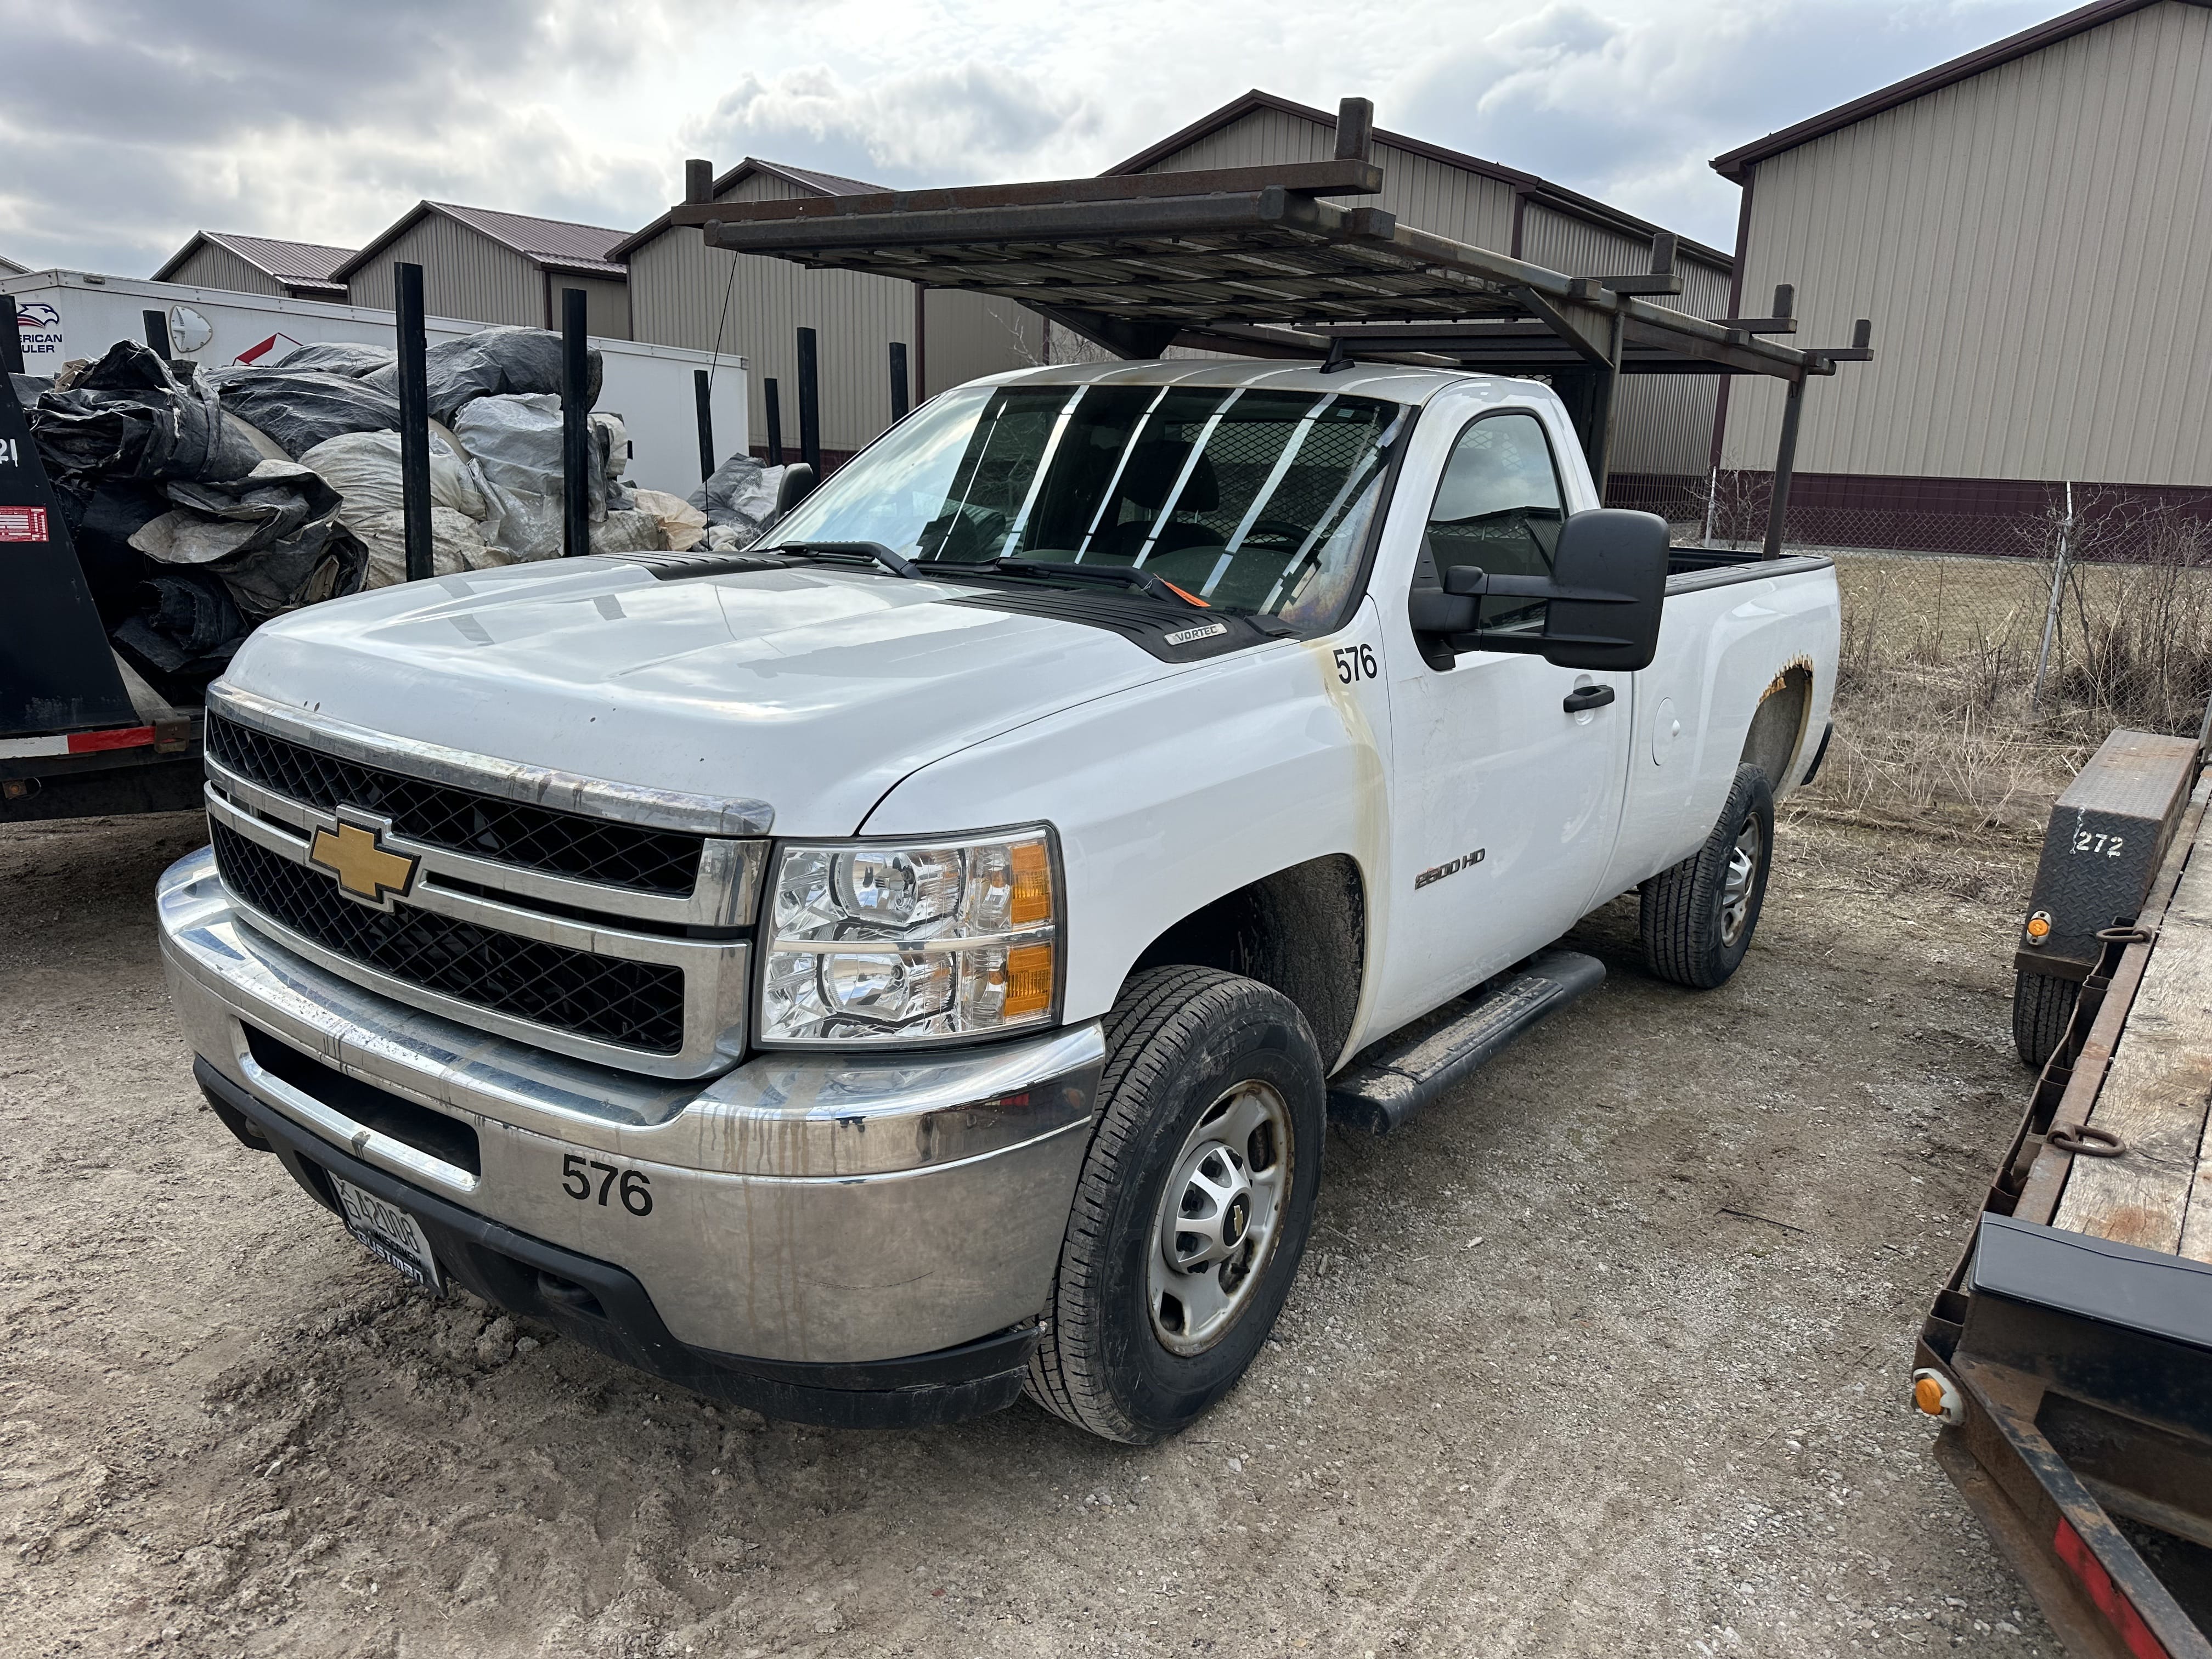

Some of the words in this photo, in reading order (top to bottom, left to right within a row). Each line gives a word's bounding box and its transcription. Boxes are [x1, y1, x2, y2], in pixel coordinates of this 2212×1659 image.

[1175, 625, 1218, 641] VORTEC
[1332, 643, 1378, 684] 576
[2076, 830, 2123, 857] 272
[1414, 858, 1460, 890] 2500
[1462, 848, 1486, 870] HD
[562, 1153, 653, 1217] 576
